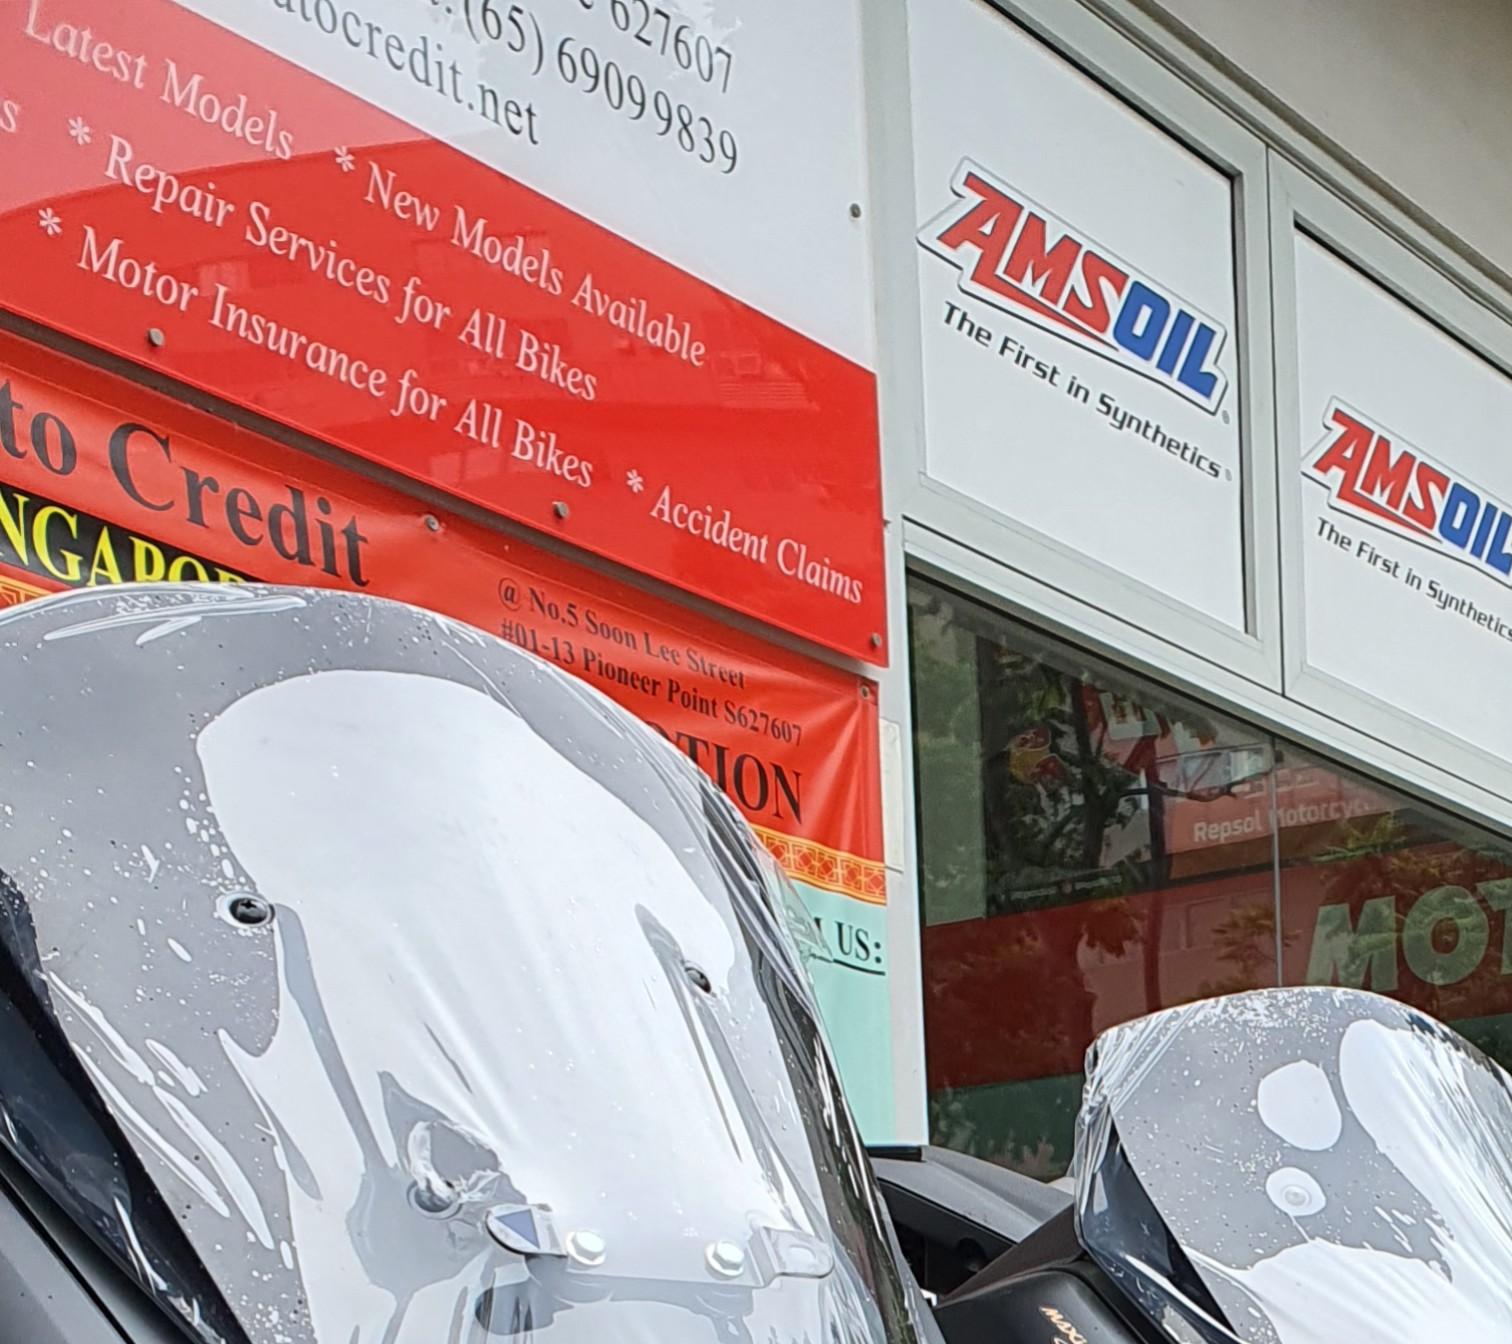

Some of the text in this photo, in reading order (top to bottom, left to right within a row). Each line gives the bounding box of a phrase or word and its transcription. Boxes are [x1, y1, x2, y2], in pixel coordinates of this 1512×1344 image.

[24, 0, 294, 160] Latest Models
[105, 134, 598, 402] Repair Services for All Bikes
[363, 161, 706, 368] New Models Available
[936, 170, 1219, 400] AMSOIL
[77, 224, 594, 488] Motor Insurance for All Bikes
[942, 301, 1222, 480] The First in Synthetics
[108, 422, 370, 588] Credit
[649, 485, 864, 604] Accident Claims
[1316, 516, 1352, 551] The
[1356, 540, 1402, 579] First
[1405, 567, 1423, 591] in
[501, 617, 801, 747] #01-13 Pioneer Point S627607
[528, 586, 579, 628] No.5
[585, 609, 638, 651] Soon
[643, 632, 680, 667] Lee
[685, 648, 745, 691] Street
[645, 720, 803, 825] TION
[1193, 807, 1263, 845] Repsol
